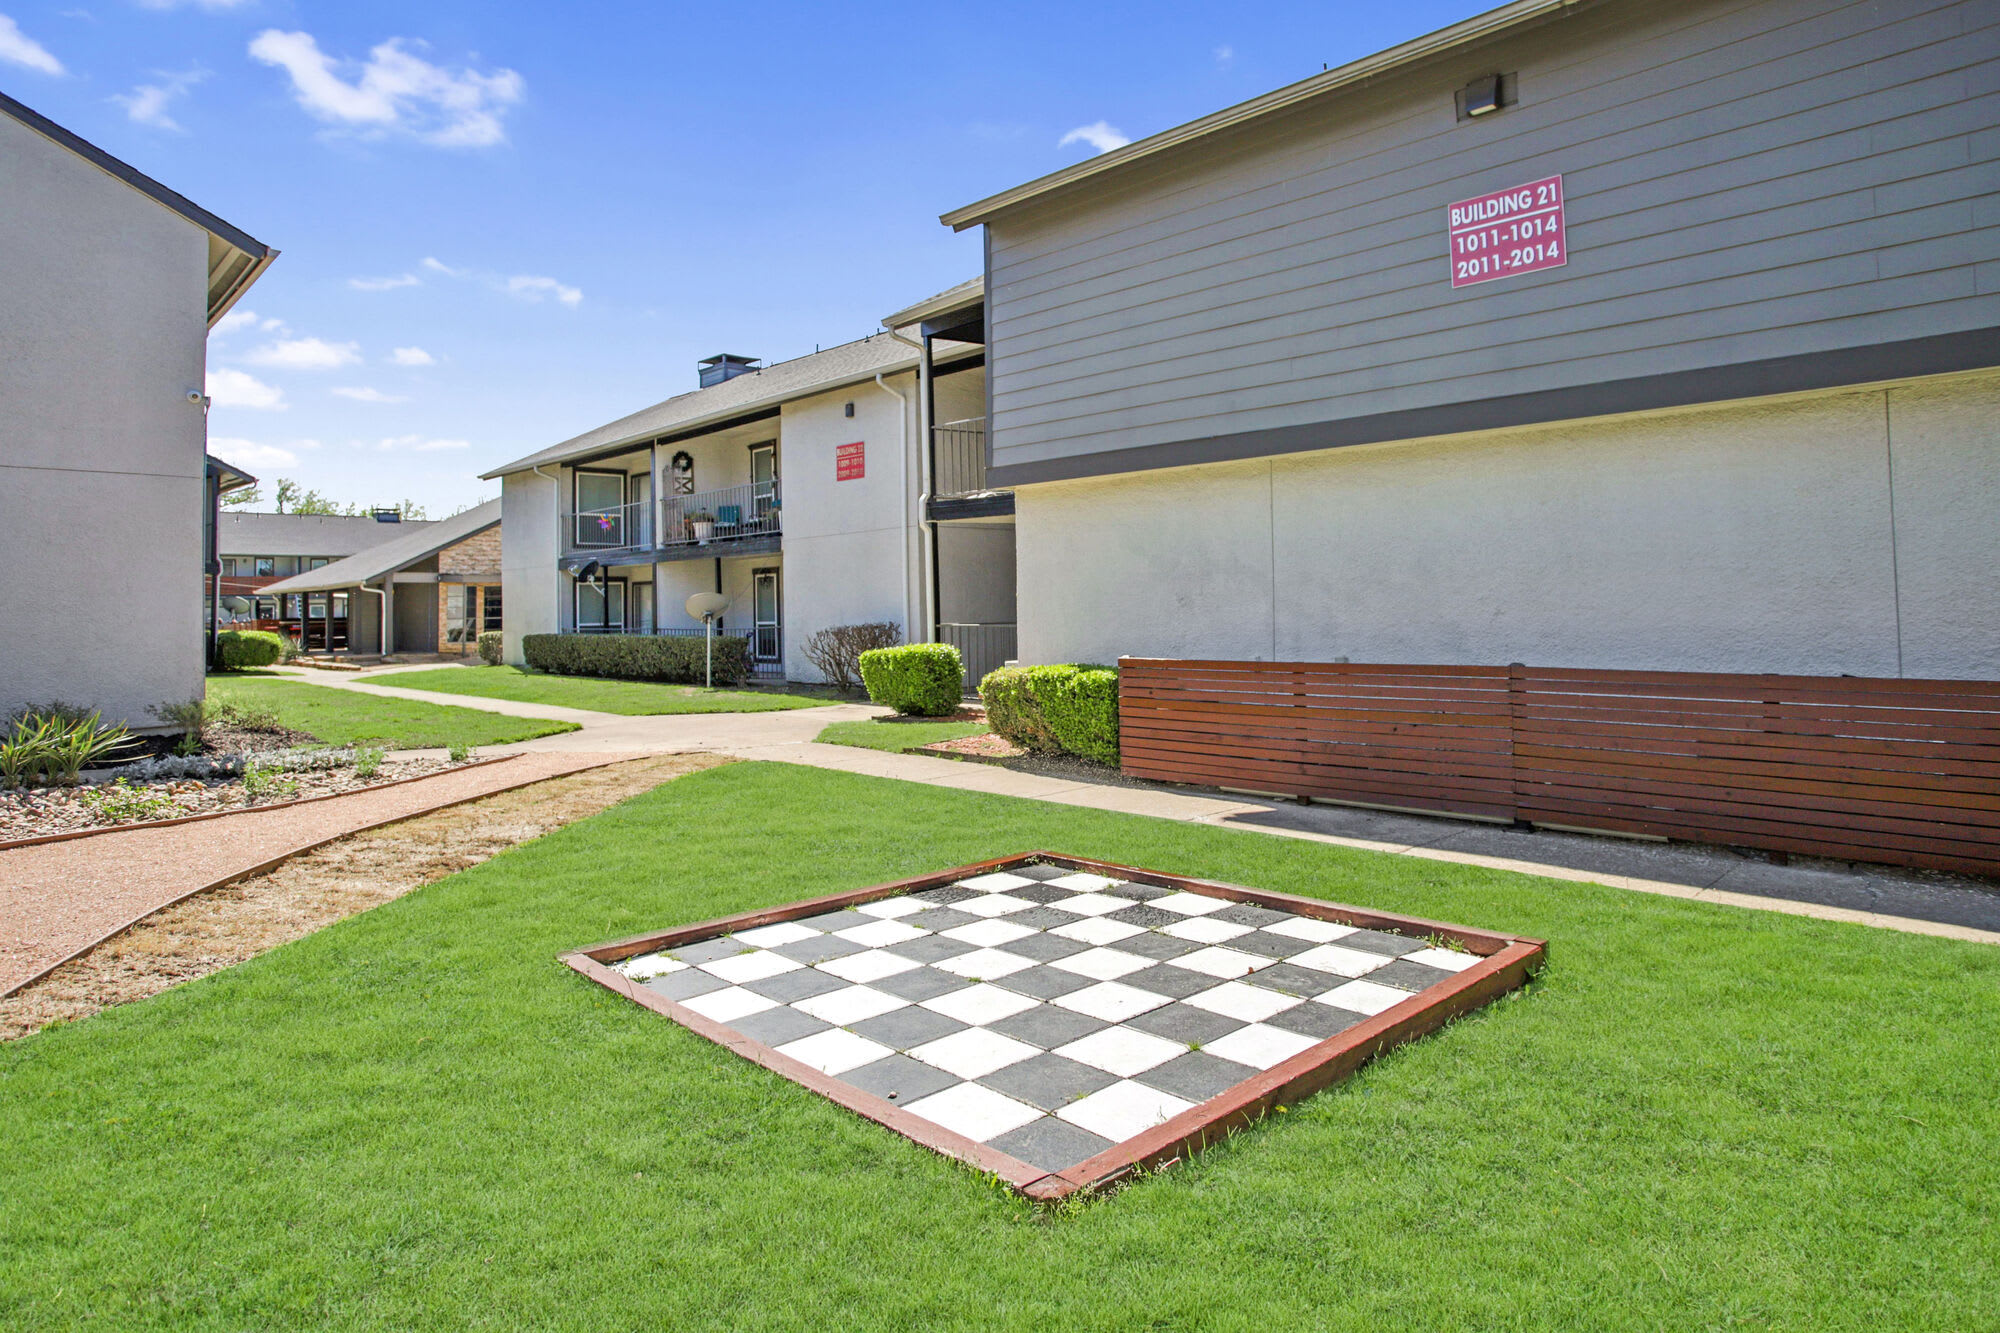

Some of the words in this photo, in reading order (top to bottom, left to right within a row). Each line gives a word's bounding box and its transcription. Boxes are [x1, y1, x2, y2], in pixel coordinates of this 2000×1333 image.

[1451, 190, 1533, 227] BUILDING
[1537, 183, 1557, 206] 21
[1457, 215, 1558, 254] 1011-1014
[1457, 240, 1560, 279] 2011-2014
[836, 445, 857, 456] BUILDING
